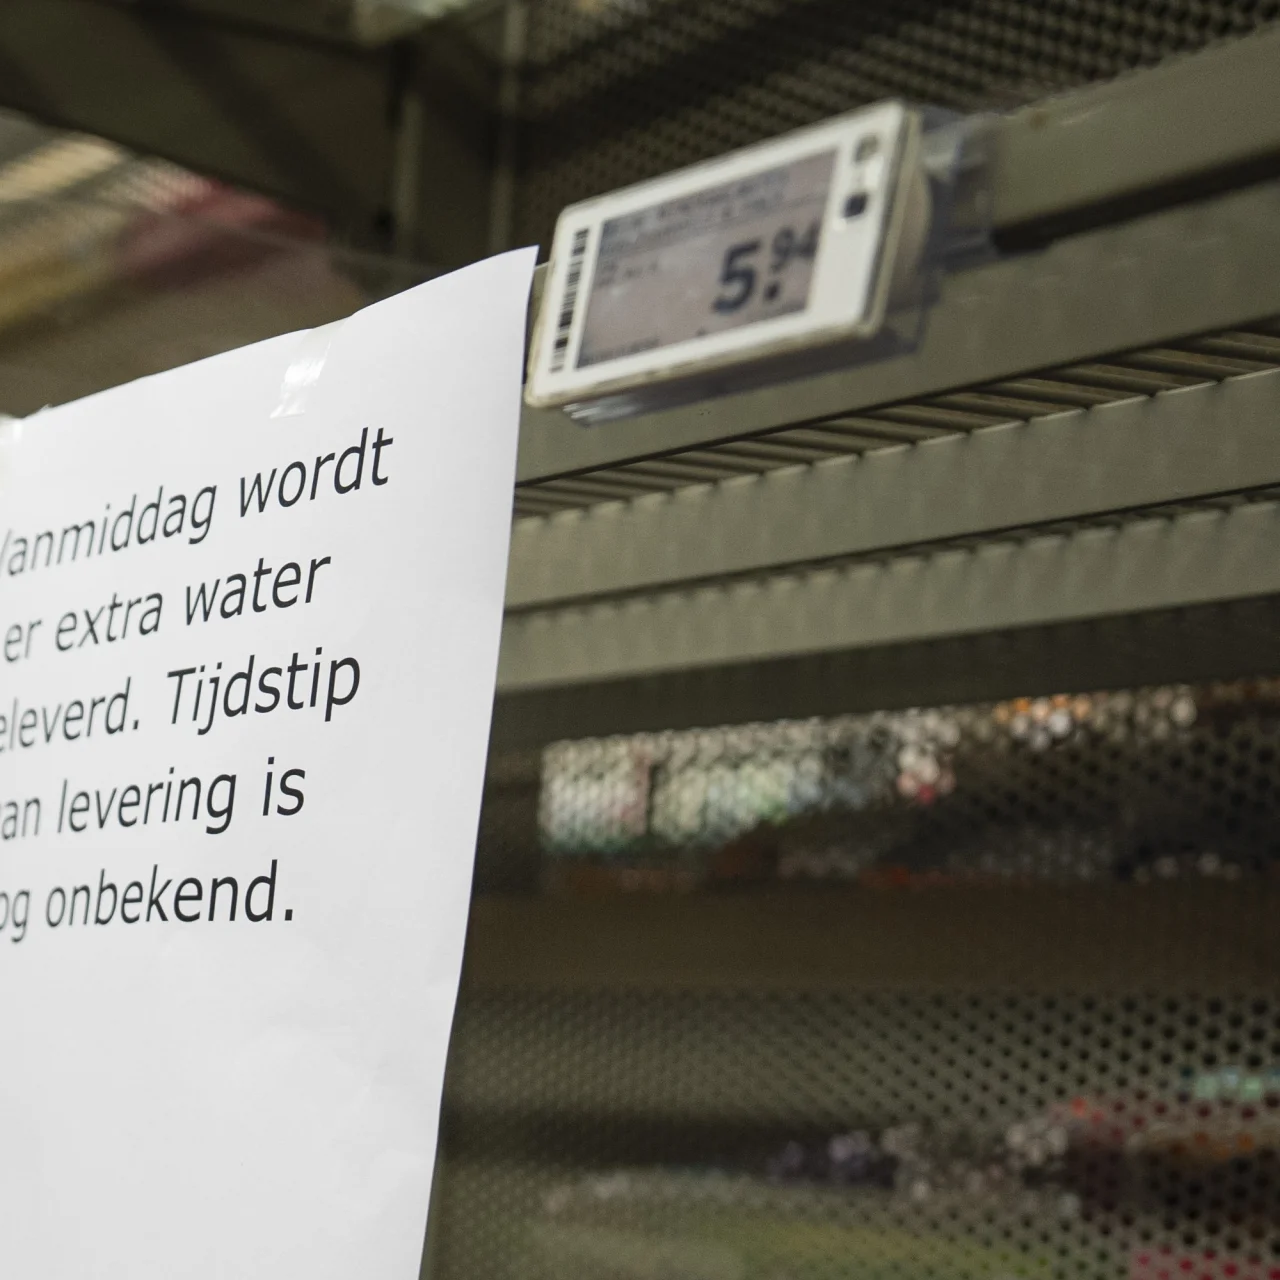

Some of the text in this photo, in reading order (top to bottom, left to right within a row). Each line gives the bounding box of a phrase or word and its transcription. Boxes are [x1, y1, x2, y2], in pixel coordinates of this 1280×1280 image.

[239, 426, 395, 519] wordt
[3, 556, 332, 664] er extra water
[166, 646, 361, 736] Tijdstip
[56, 766, 238, 836] levering
[261, 756, 307, 817] is
[45, 858, 294, 929] onbekend.
